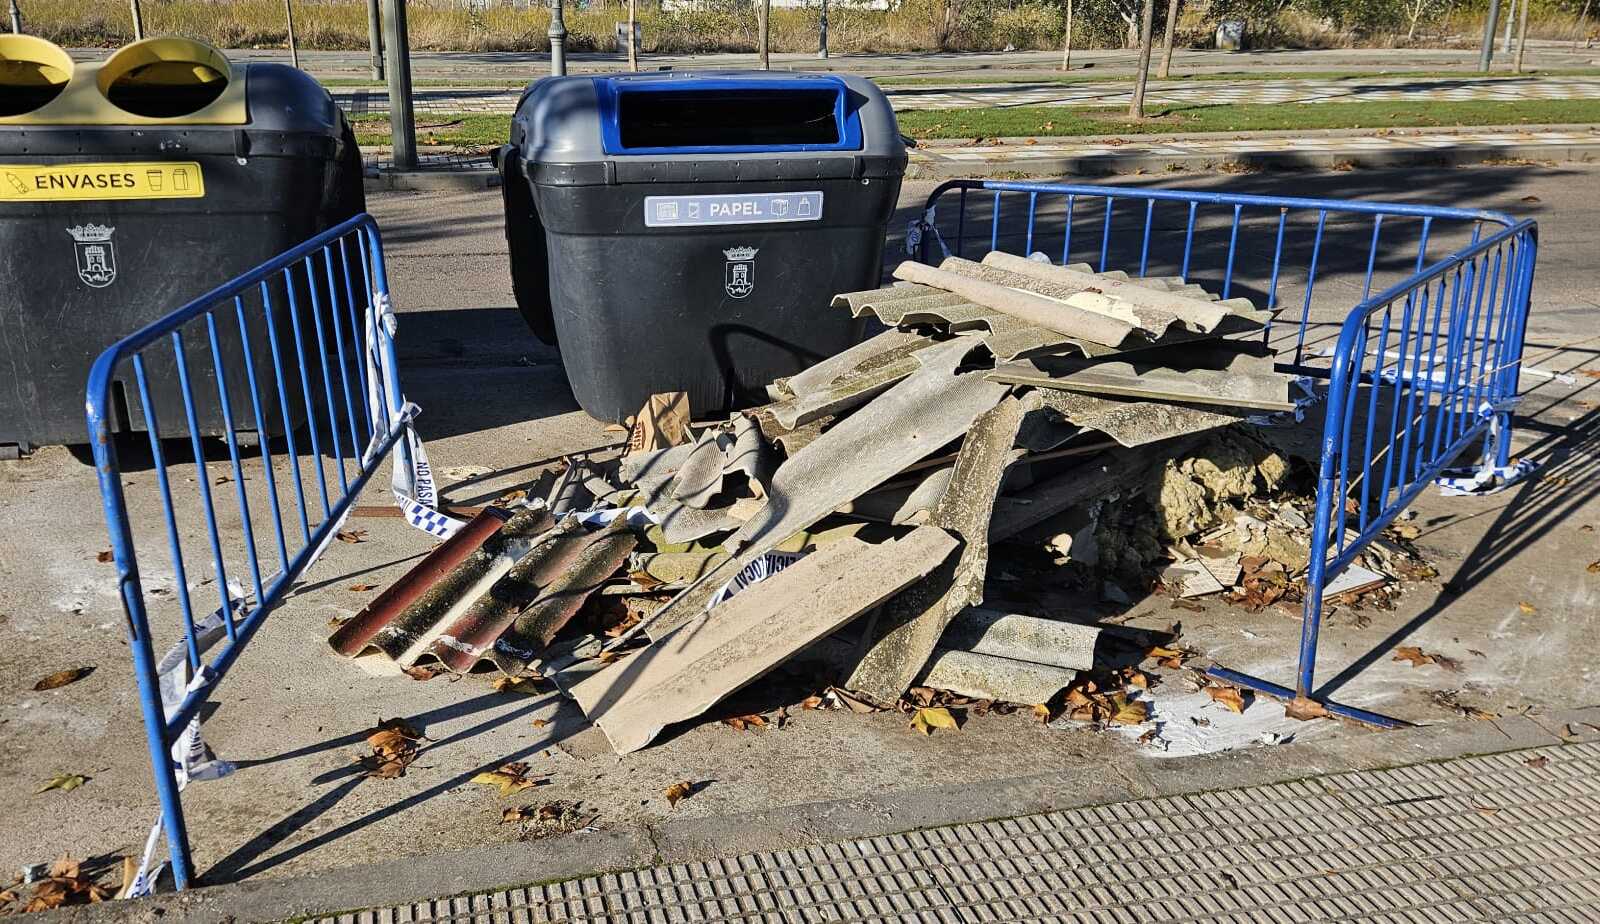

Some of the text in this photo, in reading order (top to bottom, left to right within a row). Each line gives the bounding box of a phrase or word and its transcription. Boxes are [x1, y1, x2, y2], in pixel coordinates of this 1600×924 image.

[35, 173, 136, 189] ENVASES
[709, 202, 763, 217] PAPEL
[416, 461, 430, 476] NO
